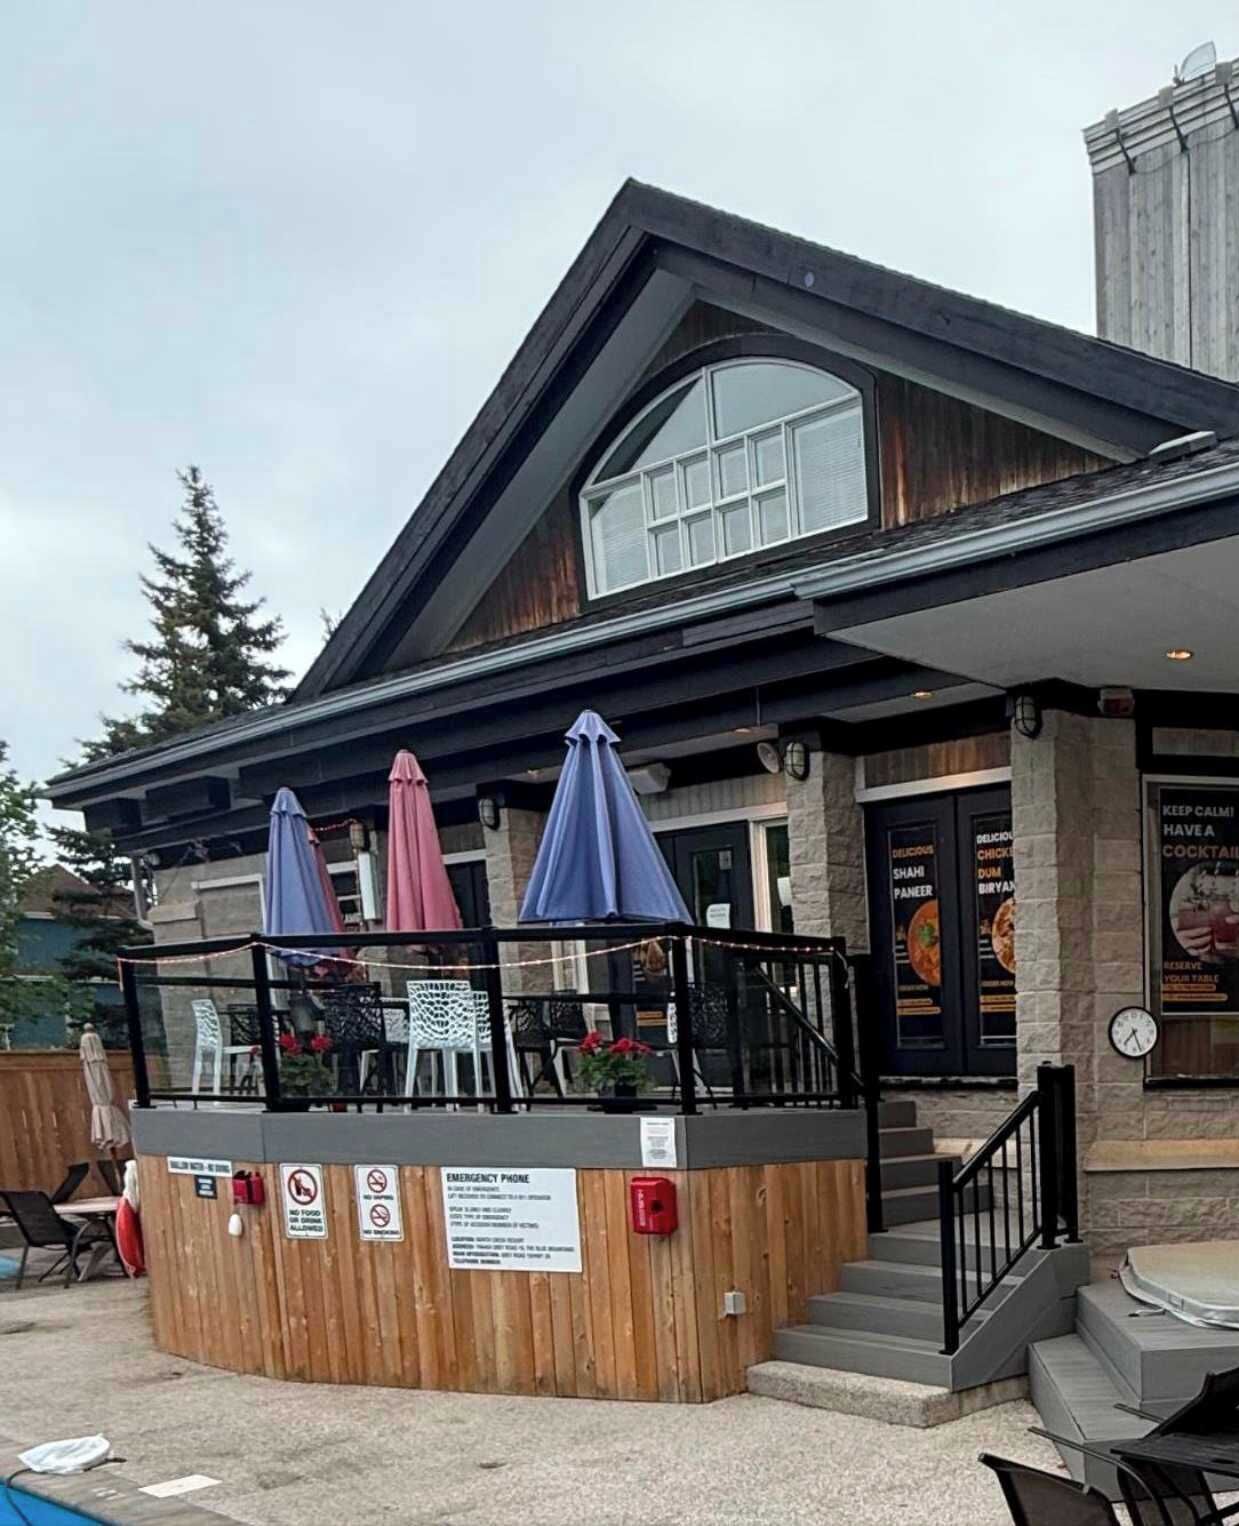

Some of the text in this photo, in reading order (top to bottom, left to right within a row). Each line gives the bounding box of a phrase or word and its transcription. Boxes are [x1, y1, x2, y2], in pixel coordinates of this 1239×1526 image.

[1162, 804, 1193, 817] KEEP
[1163, 823, 1216, 837] HAVE A
[976, 831, 1014, 844] DELICIOU
[892, 844, 934, 859] DELICIOUS
[892, 865, 925, 880] SHAHI
[977, 866, 1001, 879] DUM
[893, 885, 934, 900] PANEER
[978, 880, 1016, 895] BIRYAN
[446, 1172, 530, 1184] EMERGENCY PHONE
[289, 1224, 323, 1232] ALLOWED
